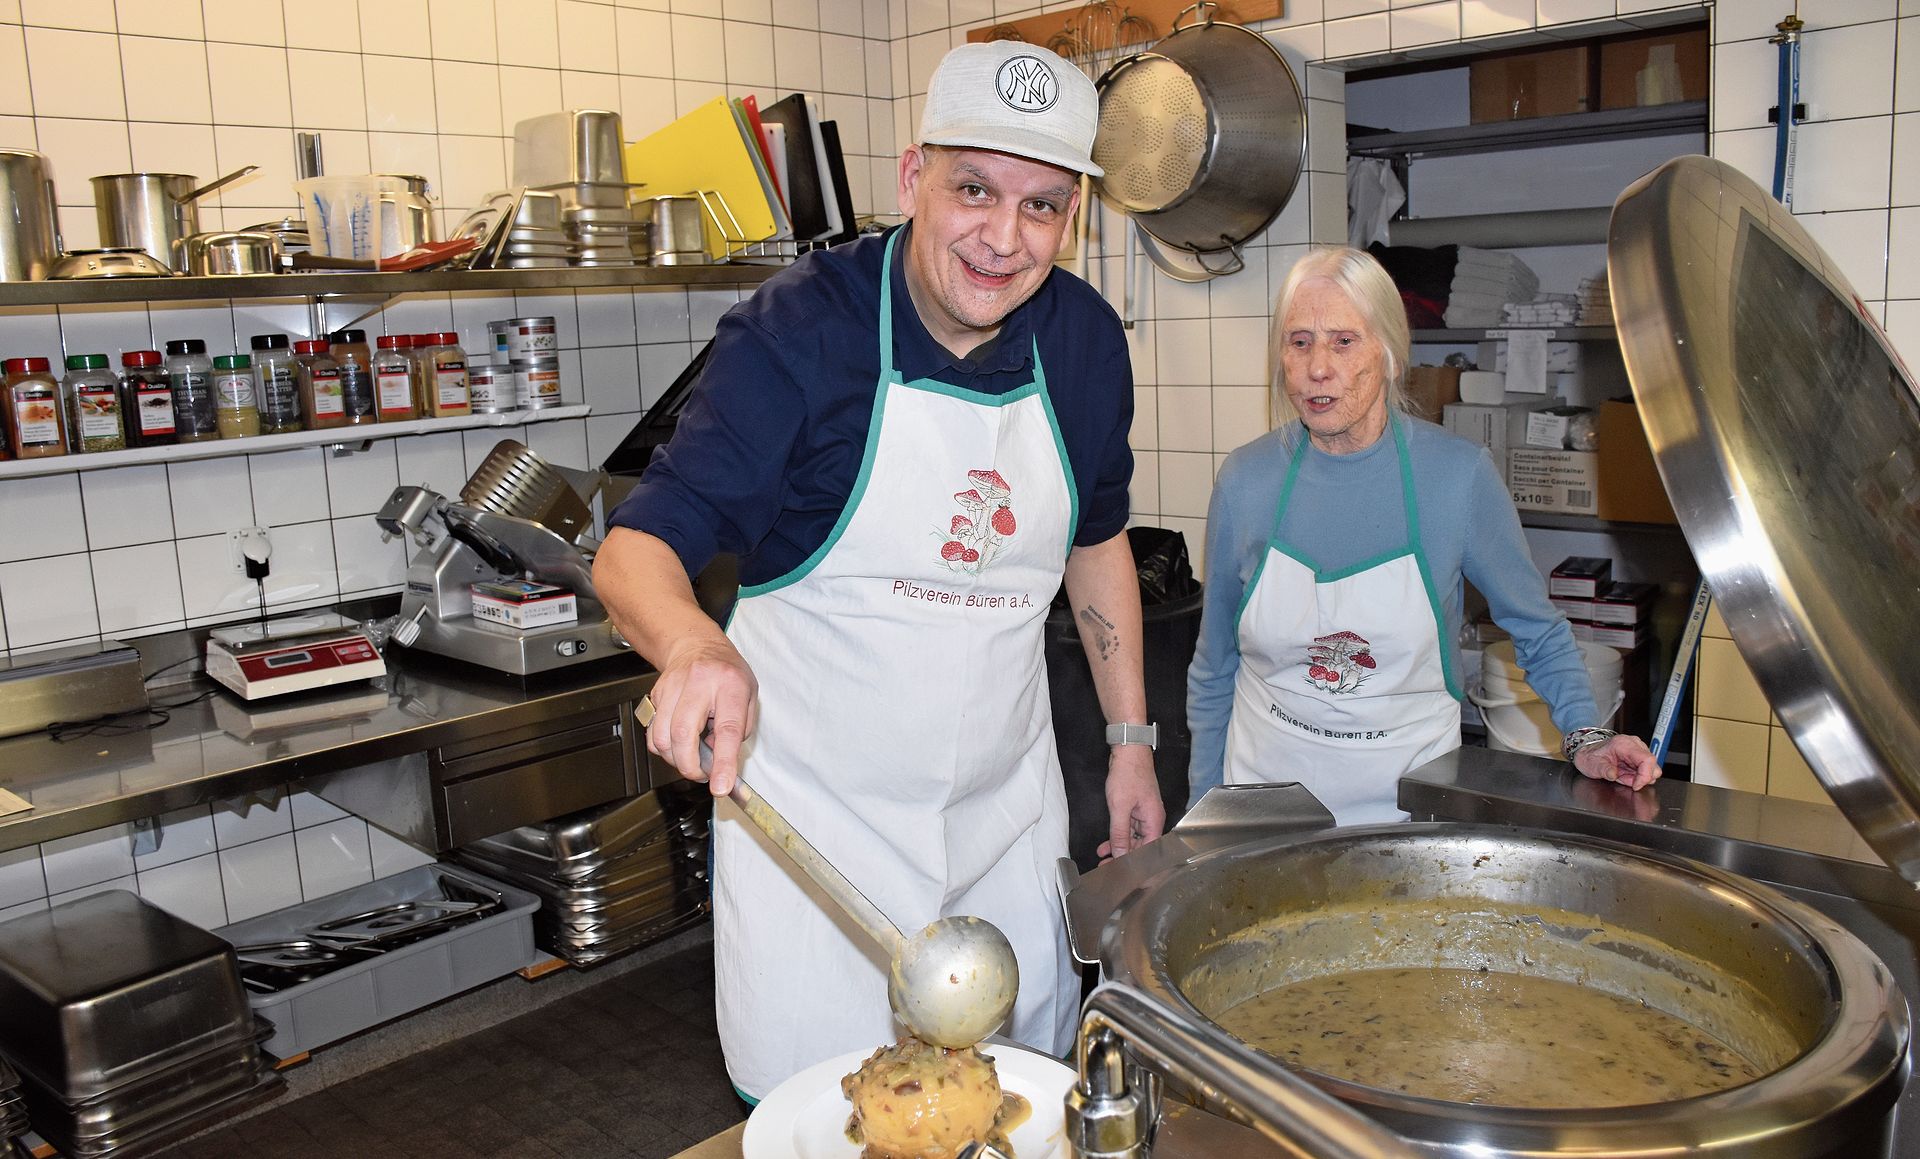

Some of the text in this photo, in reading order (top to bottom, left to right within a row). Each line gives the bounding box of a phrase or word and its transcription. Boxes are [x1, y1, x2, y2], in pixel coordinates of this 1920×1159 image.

[1549, 466, 1585, 474] Container
[1551, 478, 1586, 486] Container
[892, 580, 1034, 609] Pilzverein Büren a.A.
[1269, 703, 1388, 740] Pilzverein Büren a.A.
